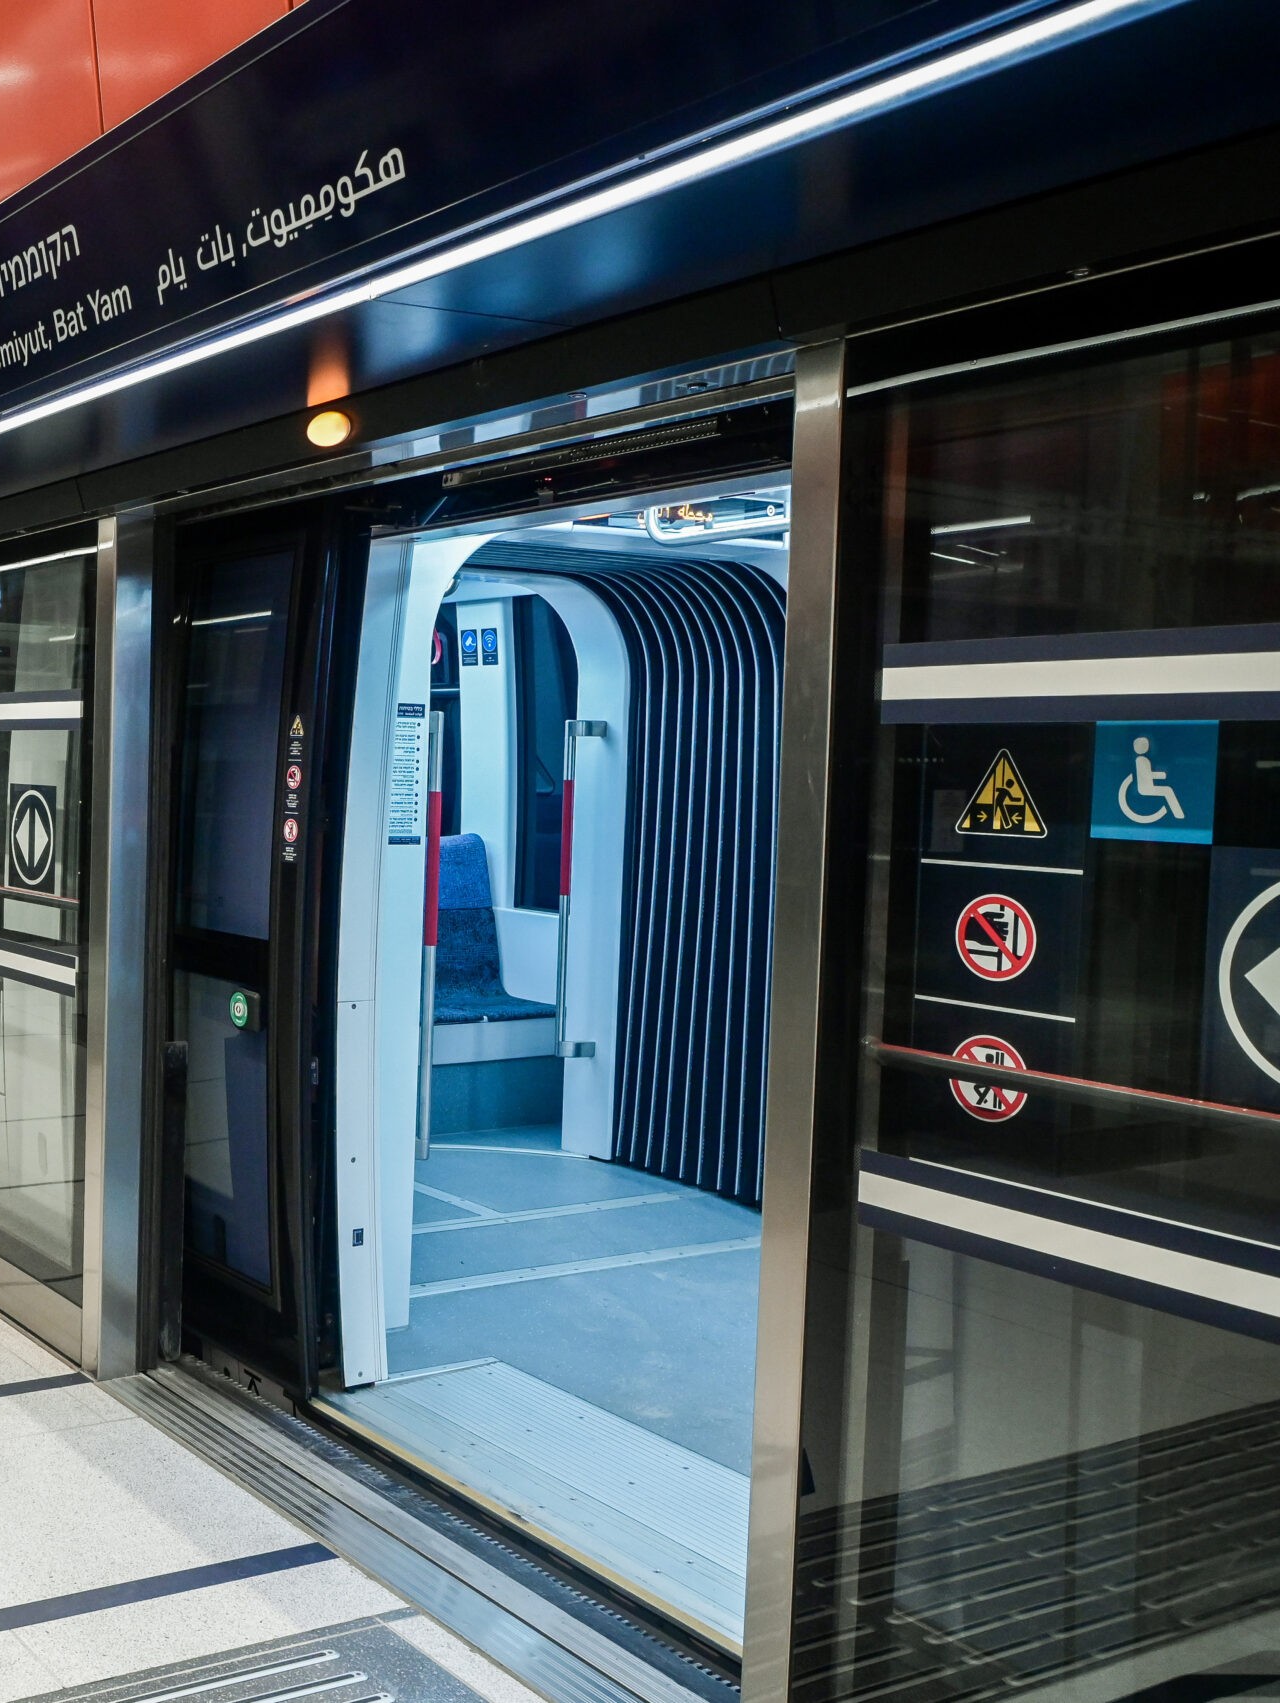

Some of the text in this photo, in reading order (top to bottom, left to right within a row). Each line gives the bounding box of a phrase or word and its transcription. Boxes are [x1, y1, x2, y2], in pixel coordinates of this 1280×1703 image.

[196, 224, 236, 271] بات
[156, 248, 188, 306] يام
[52, 302, 88, 343] Bat
[86, 285, 132, 326] Yam
